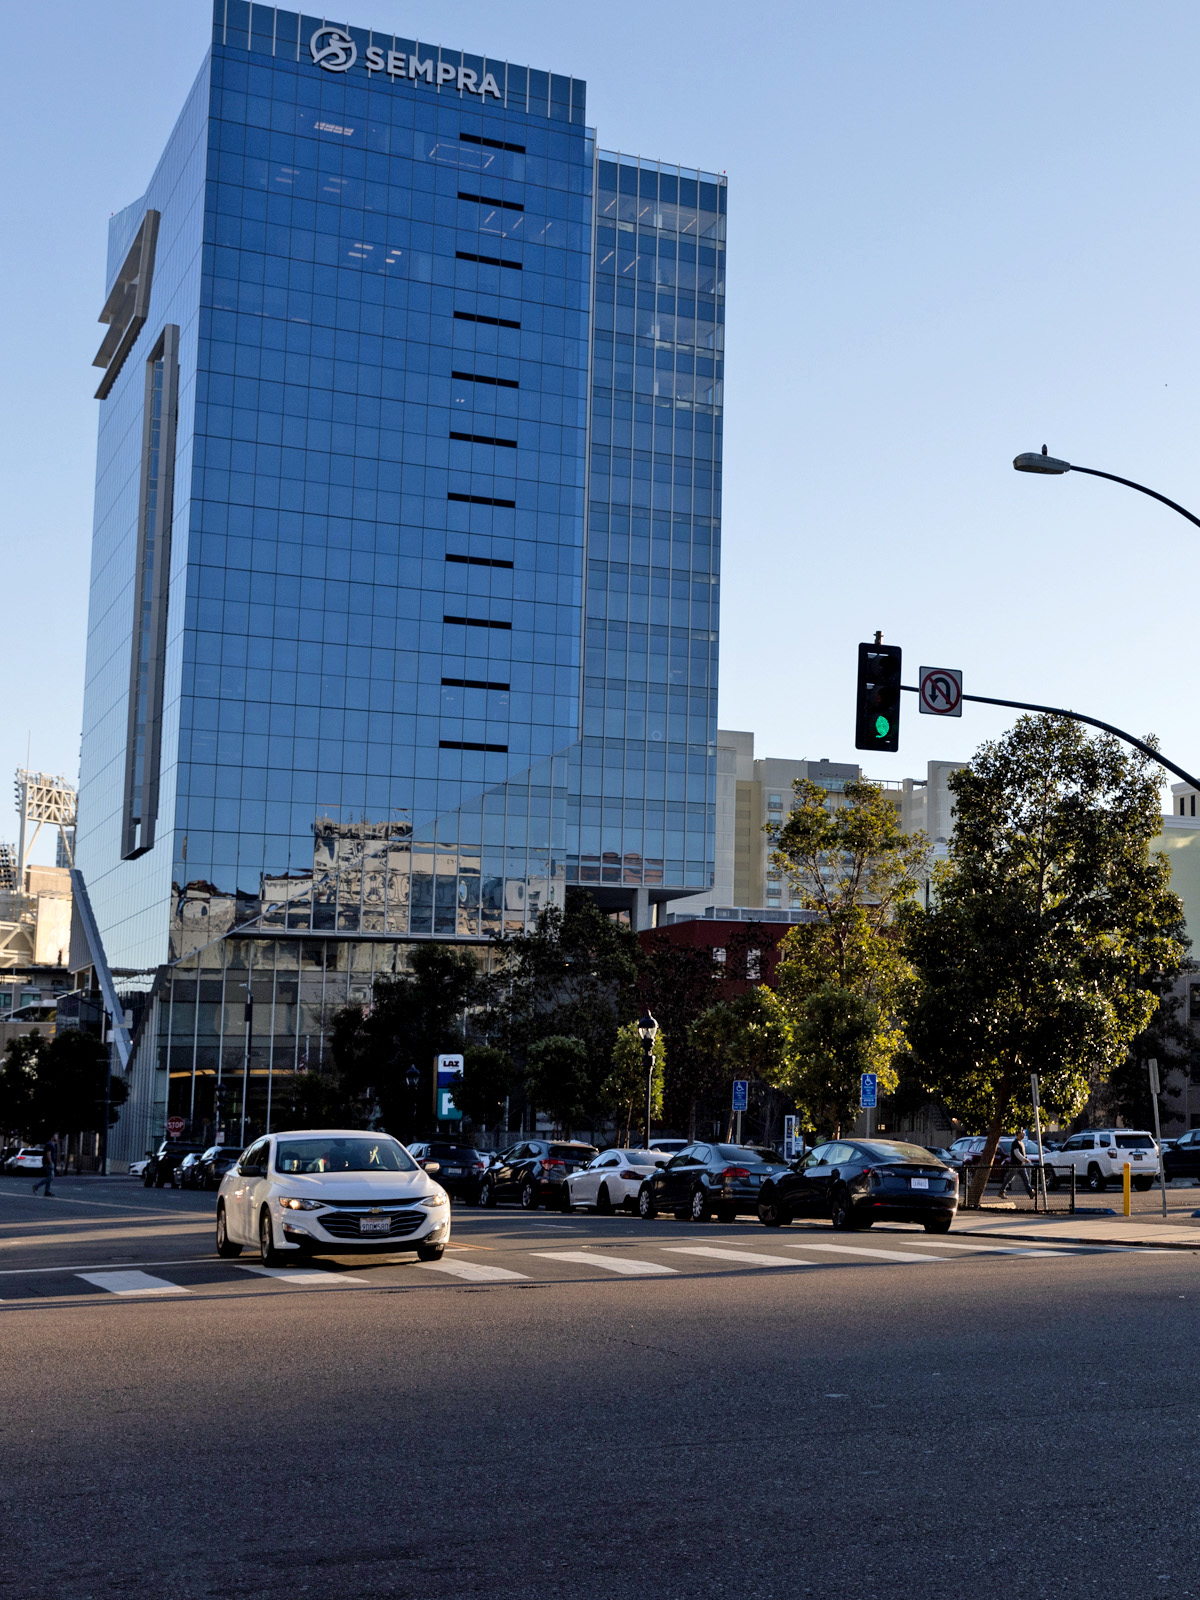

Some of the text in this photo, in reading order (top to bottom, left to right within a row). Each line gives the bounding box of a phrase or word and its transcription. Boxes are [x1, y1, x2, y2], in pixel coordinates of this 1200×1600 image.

[365, 46, 502, 99] SEMPRA
[443, 1060, 460, 1068] LAZ
[168, 1121, 184, 1129] STOP
